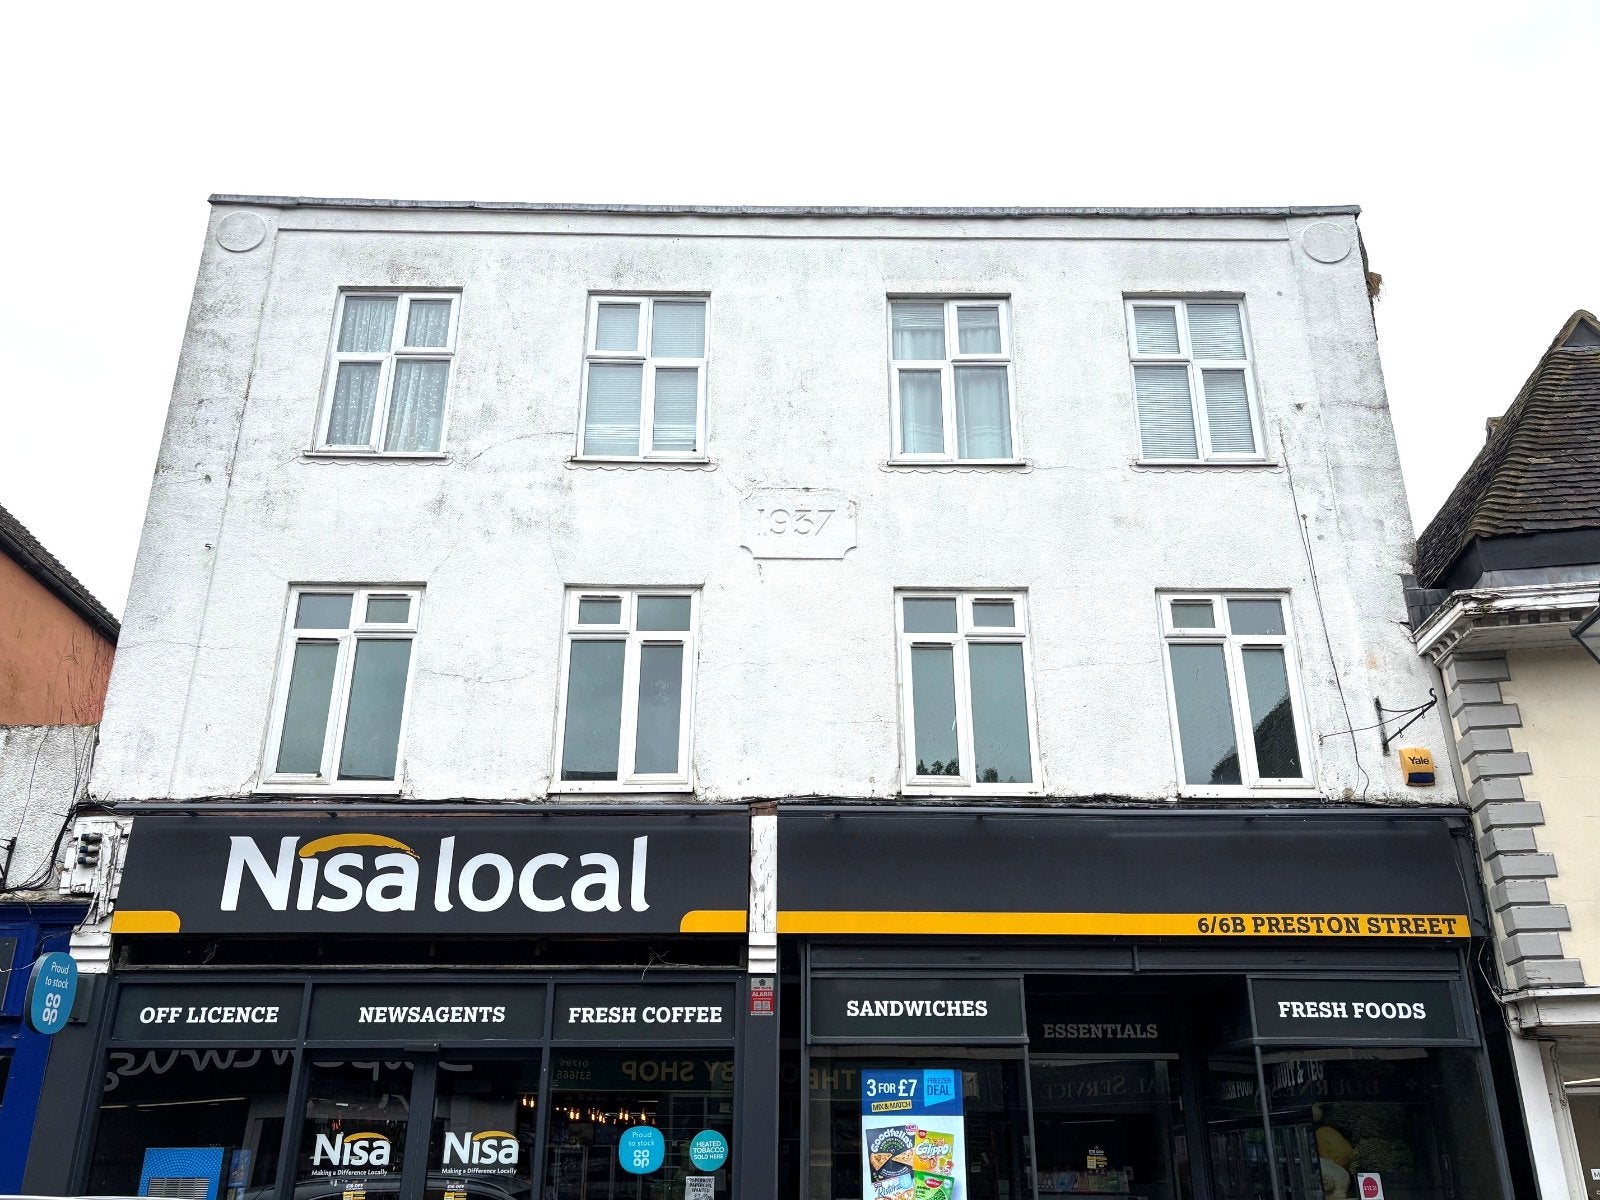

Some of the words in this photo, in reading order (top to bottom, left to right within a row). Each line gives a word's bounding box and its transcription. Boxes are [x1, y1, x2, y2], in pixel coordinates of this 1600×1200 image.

[757, 508, 836, 536] 1937
[1408, 756, 1430, 765] Yale
[220, 834, 420, 912] Nisa
[434, 835, 650, 912] local
[1197, 916, 1246, 933] 6/6B
[1253, 916, 1361, 934] PRESTON
[1367, 917, 1457, 935] STREET
[51, 961, 70, 975] Proud
[45, 976, 52, 986] to
[52, 978, 69, 989] stock
[139, 1006, 183, 1024] OFF
[186, 1006, 280, 1024] LICENCE
[358, 1006, 506, 1023] NEWSAGENTS
[568, 1007, 637, 1024] FRESH
[642, 1006, 722, 1023] COFFEE
[846, 1000, 988, 1017] SANDWICHES
[1278, 1001, 1349, 1018] FRESH
[1352, 1002, 1427, 1019] FOODS
[1043, 1023, 1158, 1039] ESSENTIALS
[866, 1079, 877, 1097] 3
[878, 1083, 896, 1094] FOR
[898, 1079, 918, 1097] £7
[927, 1085, 951, 1096] DEAL
[313, 1131, 391, 1166] Nisa
[443, 1130, 520, 1165] Nisa
[637, 1139, 655, 1147] stock
[367, 1169, 388, 1177] Locally
[467, 1167, 497, 1175] Difference
[497, 1167, 518, 1175] Locally
